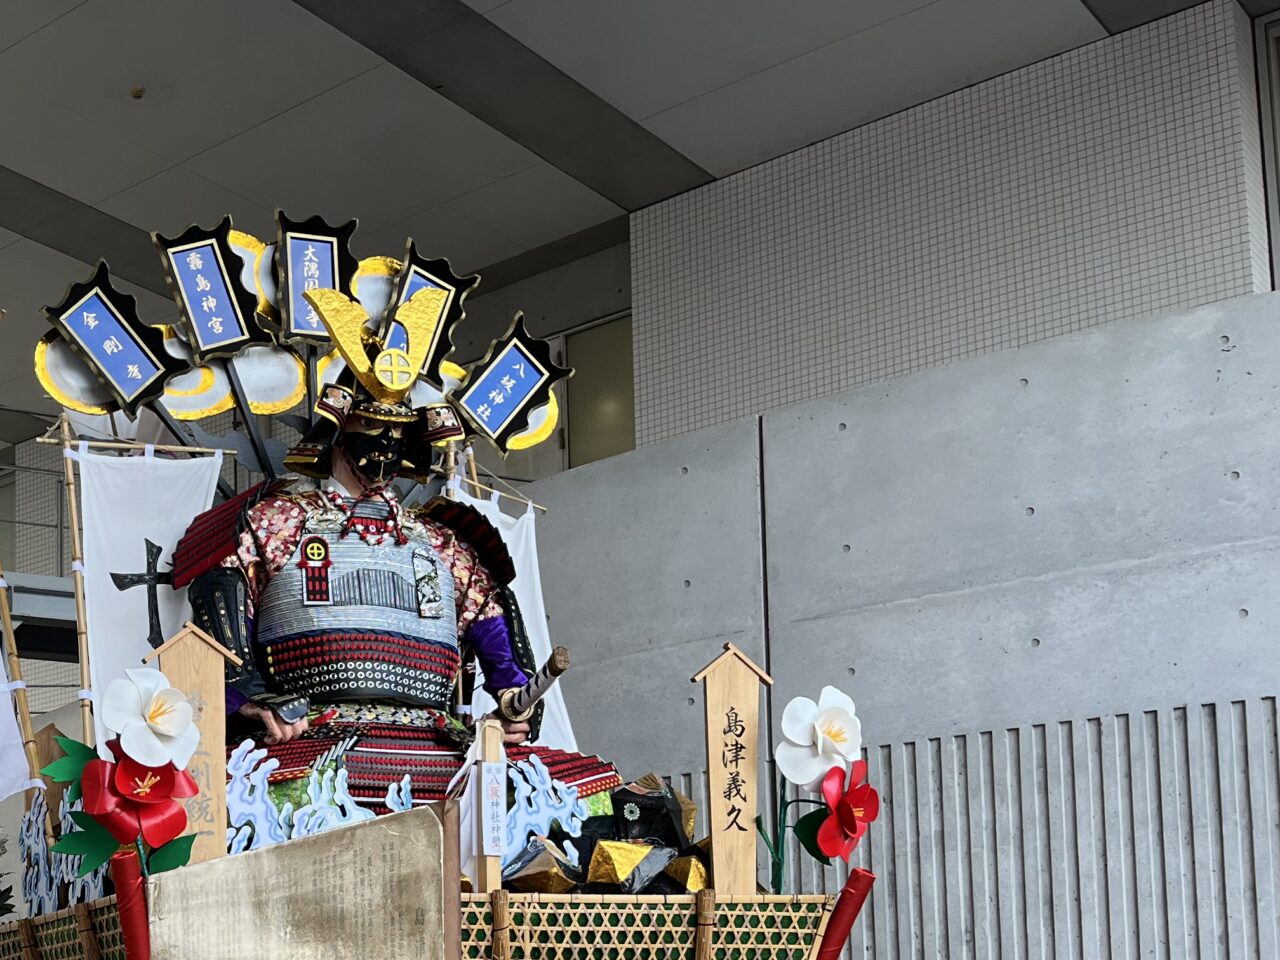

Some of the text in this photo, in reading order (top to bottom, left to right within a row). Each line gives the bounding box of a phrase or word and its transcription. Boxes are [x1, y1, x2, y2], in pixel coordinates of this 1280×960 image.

[186, 252, 224, 334] 霧島神宮
[303, 244, 320, 328] 大隅国寺
[476, 362, 526, 422] 八坂神社
[721, 705, 748, 832] 島津義久
